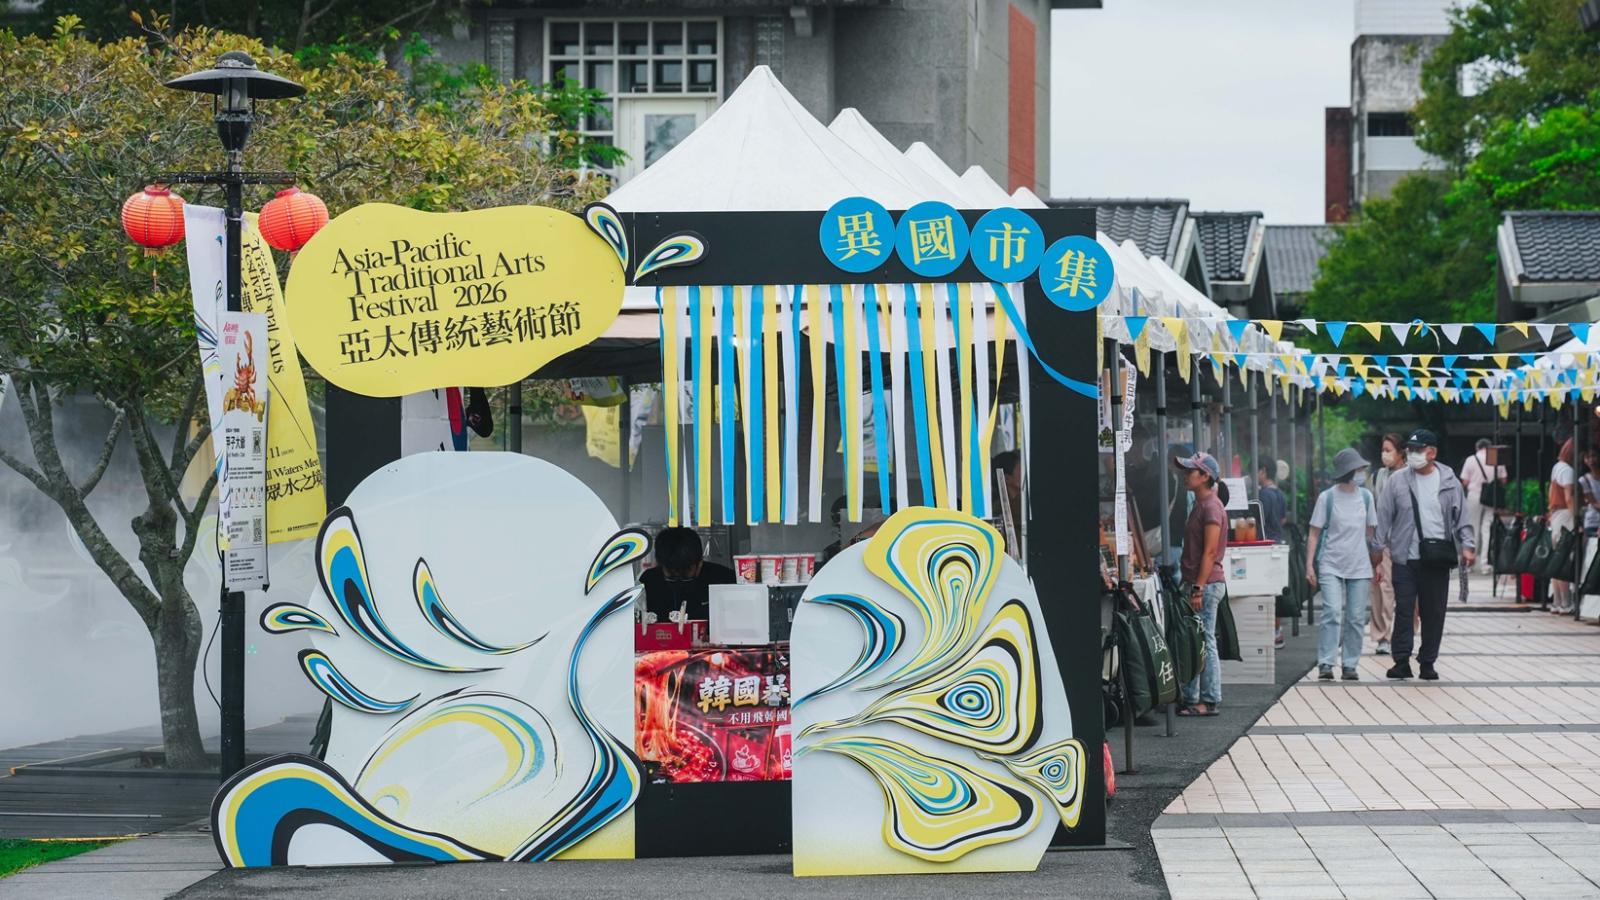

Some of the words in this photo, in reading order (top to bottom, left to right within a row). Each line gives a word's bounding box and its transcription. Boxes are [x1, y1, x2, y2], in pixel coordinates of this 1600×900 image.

[331, 232, 472, 274] Asia-Pacific
[344, 254, 485, 297] Traditional
[491, 252, 546, 277] Arts
[836, 211, 1098, 299] 異國市集
[348, 286, 439, 322] Festival
[453, 281, 507, 308] 2026
[338, 301, 581, 365] 亞太傳統藝術節
[273, 463, 304, 478] Waters
